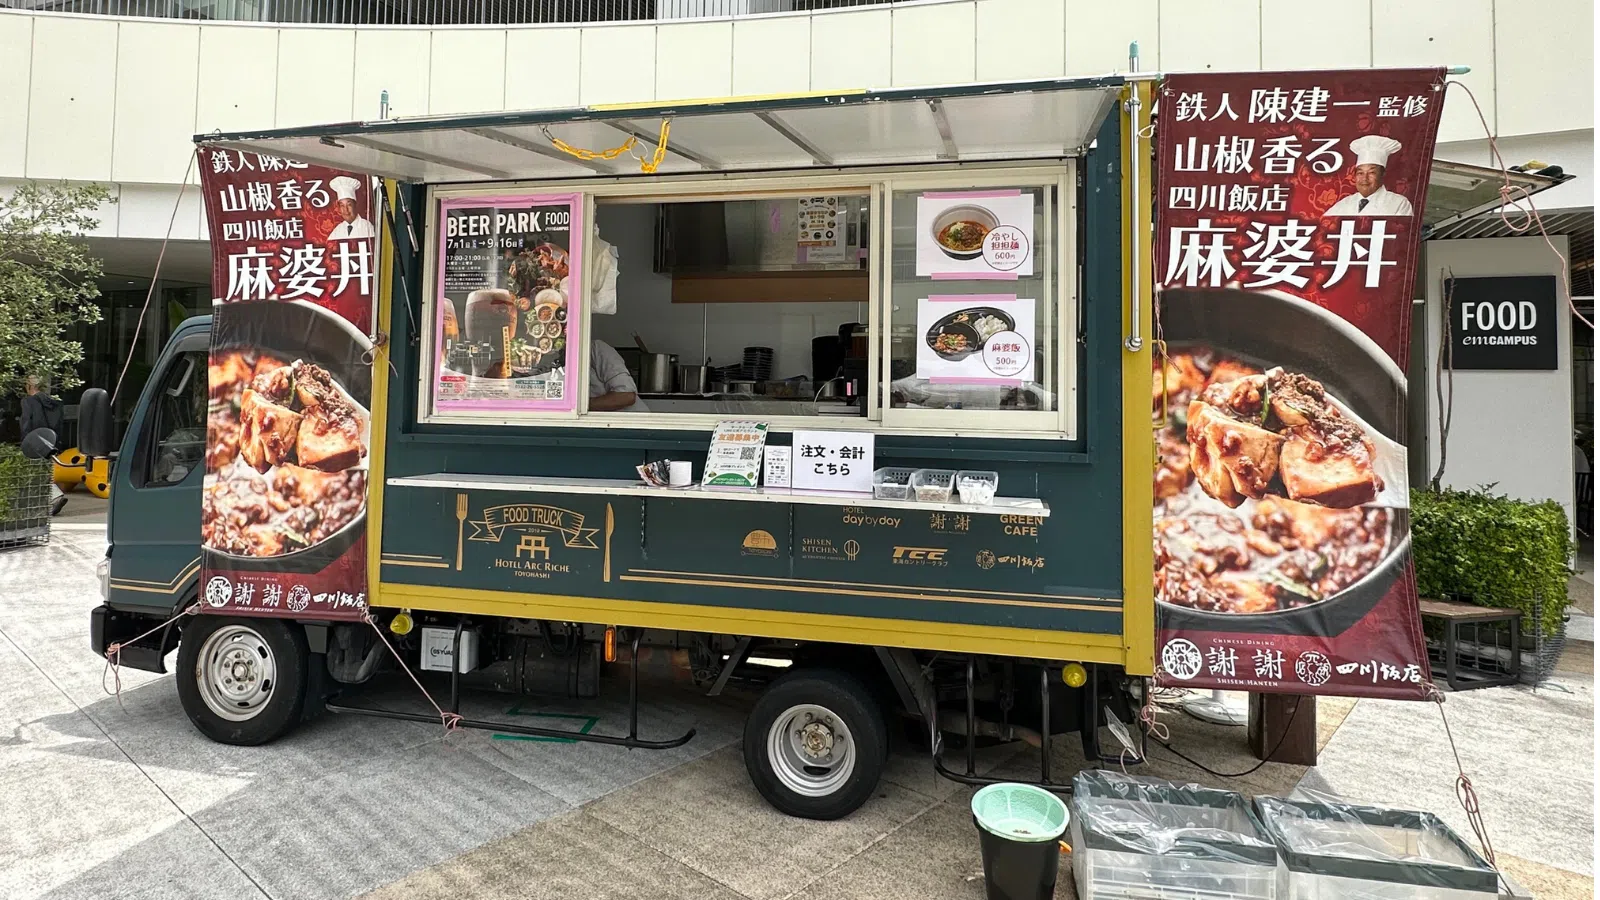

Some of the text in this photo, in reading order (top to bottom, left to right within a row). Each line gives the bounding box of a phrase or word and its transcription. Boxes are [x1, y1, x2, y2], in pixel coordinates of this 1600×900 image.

[1175, 86, 1429, 124] 鉄人 陳建一 監修
[211, 150, 254, 173] 鉄人
[1174, 135, 1344, 174] 山椒香る
[220, 179, 329, 212] 山椒香る
[1168, 183, 1290, 212] 四川飯店
[222, 217, 303, 241] 四川飯店
[447, 211, 570, 237] BEER PARK FOOD
[991, 232, 1019, 241] 冷やし
[995, 252, 1015, 260] 600円
[1164, 218, 1397, 289] 麻婆丼
[226, 241, 374, 301] 麻婆丼
[1461, 301, 1537, 331] FOOD
[992, 343, 1021, 353] 麻婆飯
[1462, 335, 1537, 346] emCAMPUS
[996, 357, 1017, 365] 500円
[801, 444, 865, 460] 注文・会計
[814, 463, 850, 476] こちら
[503, 507, 564, 526] FOOD TRUCK
[1000, 514, 1043, 525] GREEN
[1004, 525, 1038, 536] CAFE
[802, 538, 832, 546] SHISEN
[802, 545, 838, 554] KITCHEN
[892, 546, 948, 560] TCC
[495, 558, 570, 573] HOTEL ARC RICHE
[998, 555, 1045, 568] 四川飯店
[514, 570, 550, 579] TOYOHASHI
[313, 590, 365, 609] 四川飯店
[1336, 659, 1423, 684] 四川飯店
[1247, 679, 1278, 687] HANTEN
